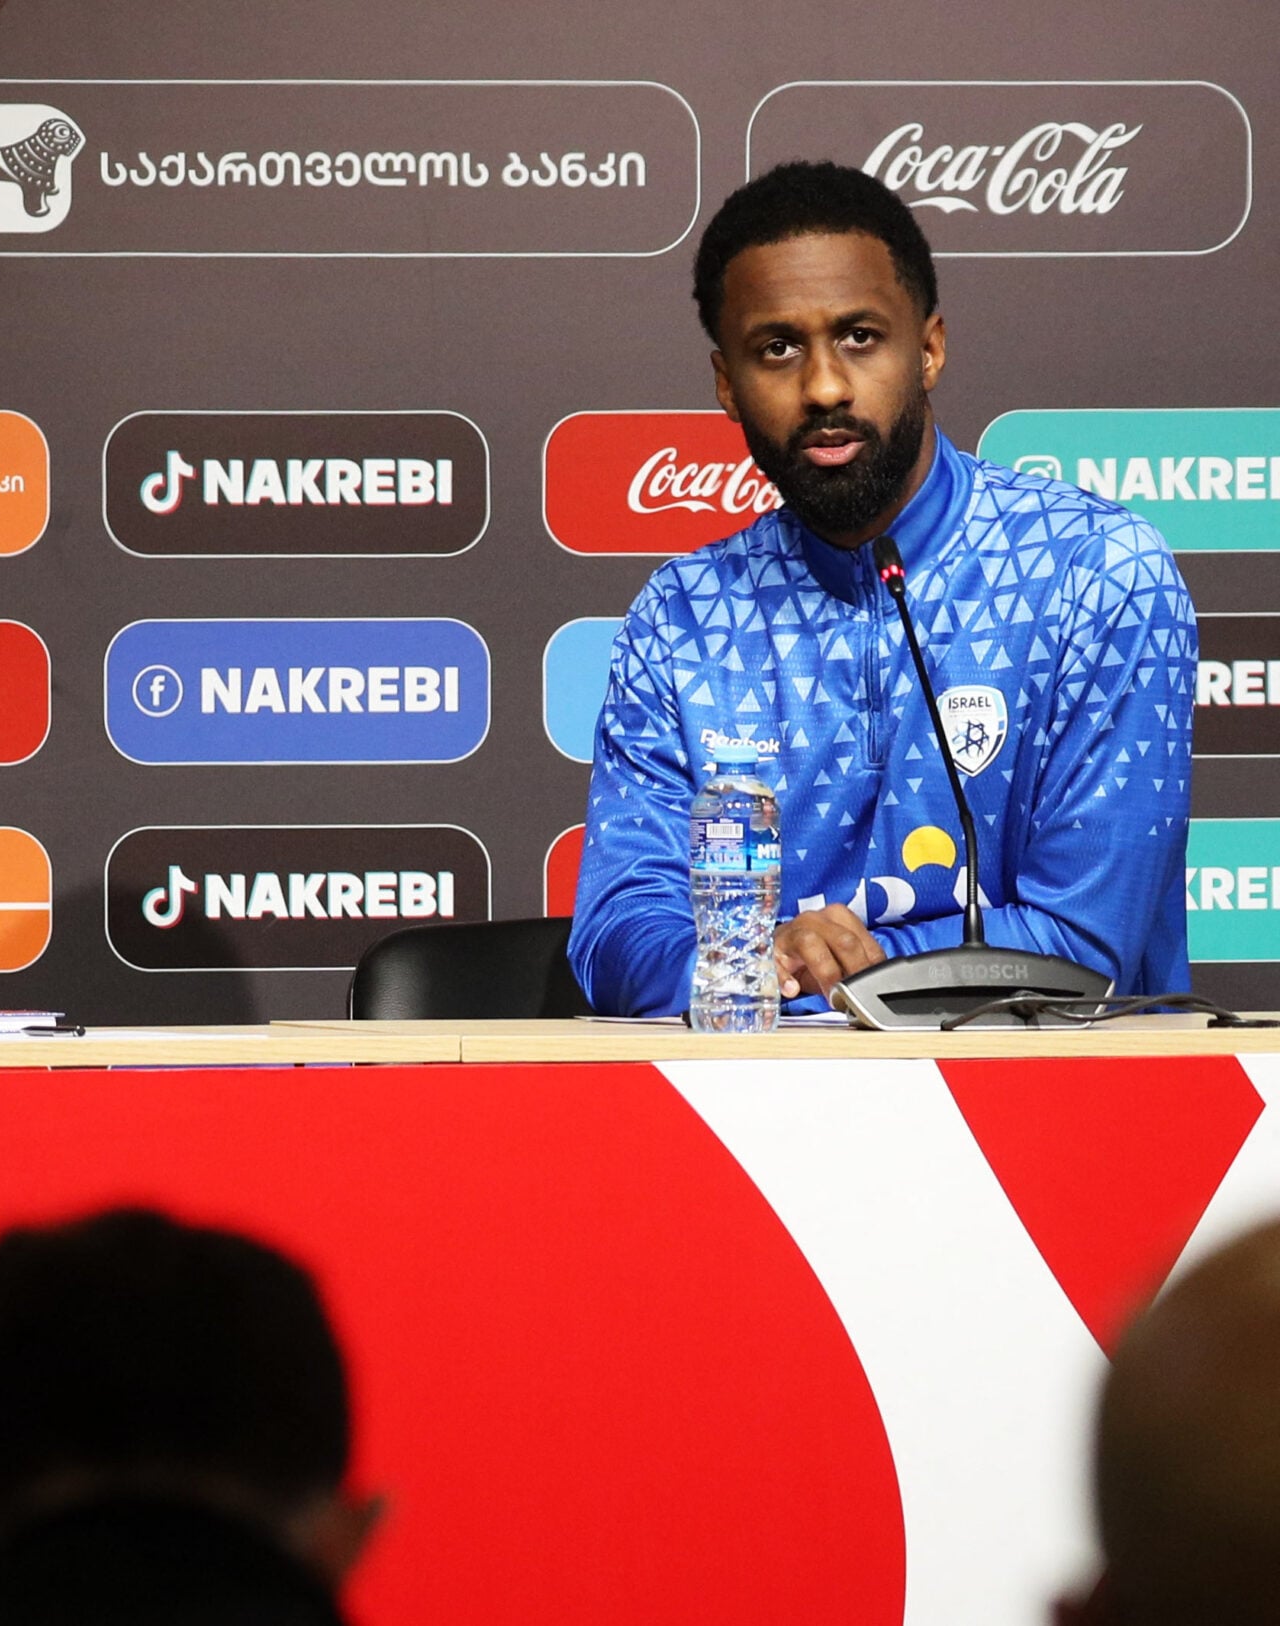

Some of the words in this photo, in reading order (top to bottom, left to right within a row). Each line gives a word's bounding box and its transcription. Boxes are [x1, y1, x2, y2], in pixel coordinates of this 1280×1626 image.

[100, 151, 490, 188] საქართველოს
[501, 152, 646, 188] ბანკი
[861, 122, 1144, 215] Coca-Cola
[202, 458, 454, 507] NAKREBI
[627, 446, 786, 514] Coca-Co
[1077, 456, 1280, 501] NAKRE
[201, 666, 460, 714] NAKREBI
[948, 696, 992, 710] ISRAEL
[205, 871, 455, 919] NAKREBI
[960, 964, 1029, 980] BOSCH
